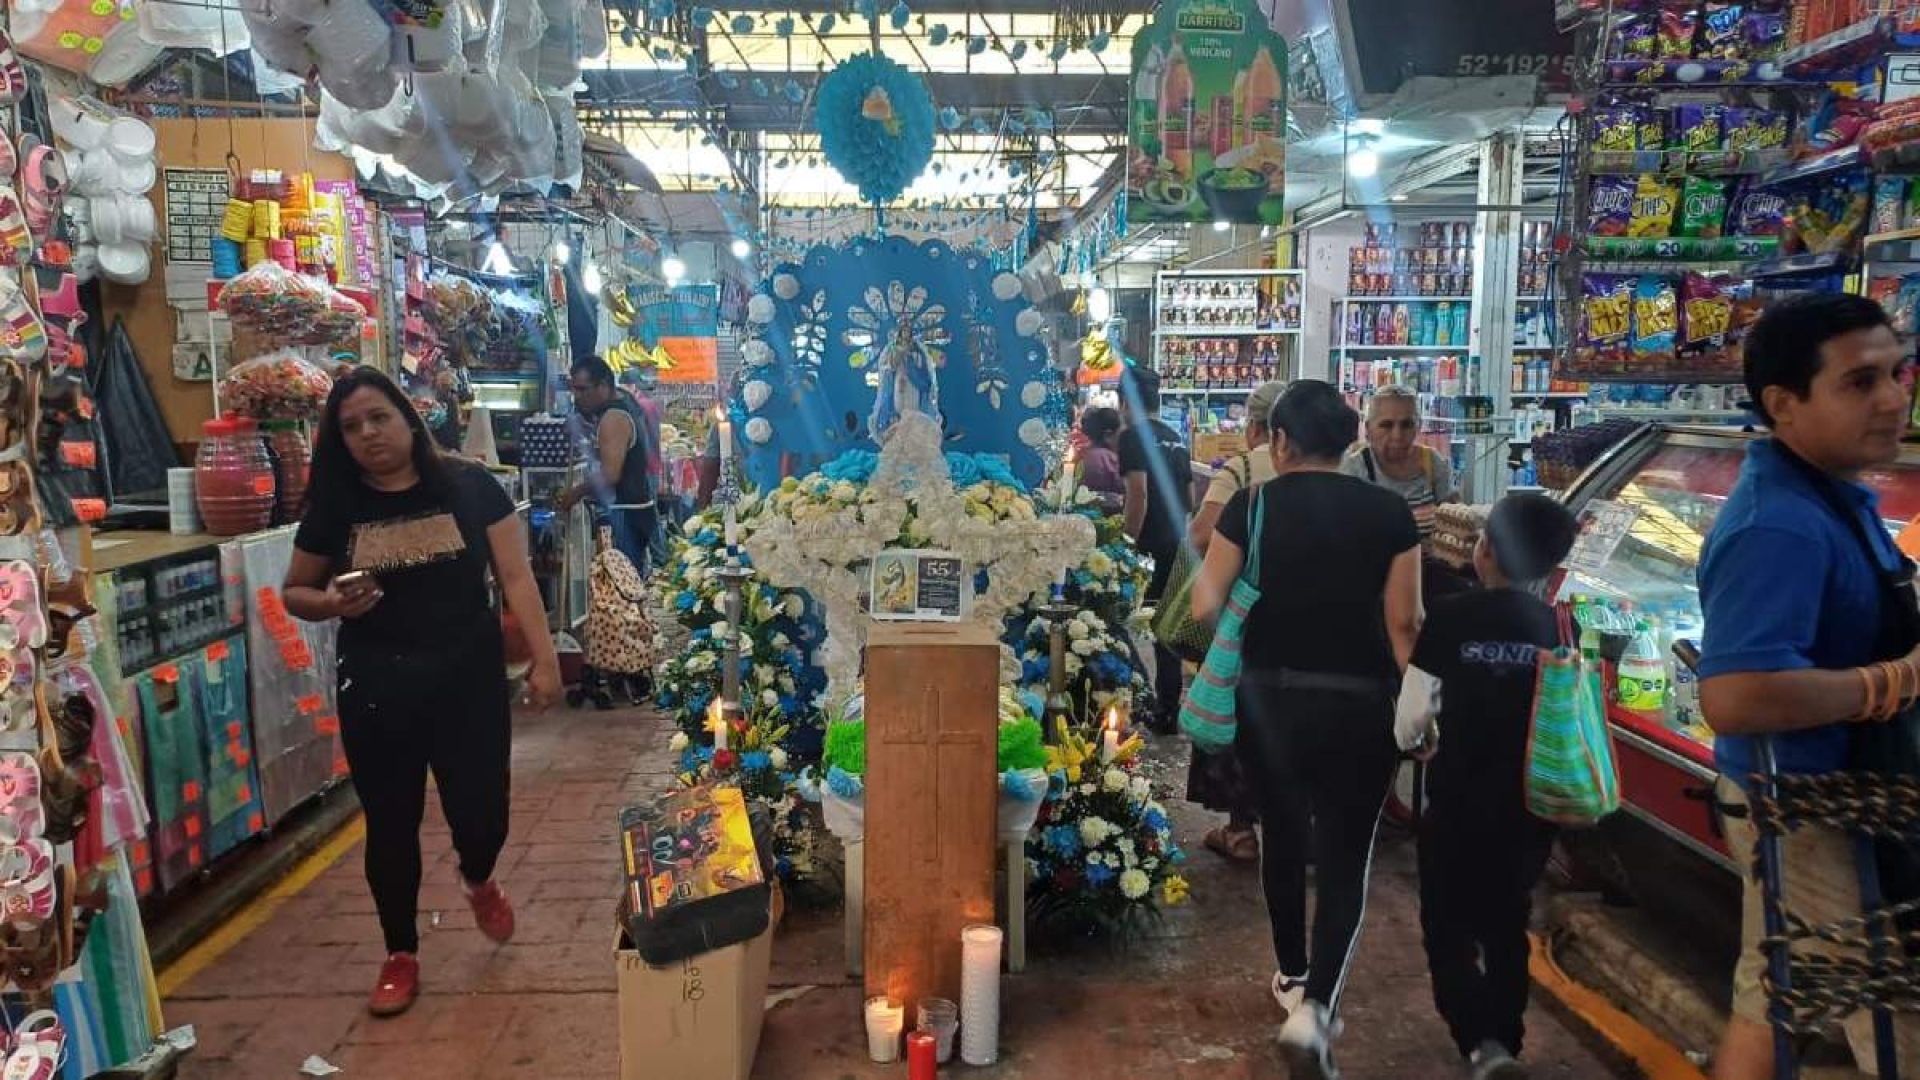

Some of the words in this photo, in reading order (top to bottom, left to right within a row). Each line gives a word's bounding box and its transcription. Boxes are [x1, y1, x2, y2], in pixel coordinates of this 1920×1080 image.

[1181, 14, 1240, 28] JARRITOS
[1200, 37, 1222, 48] 100%
[1190, 48, 1231, 59] MEXICANO
[1660, 242, 1680, 257] 20
[1742, 242, 1761, 257] 20
[926, 561, 950, 577] 55
[1460, 641, 1537, 665] SONI
